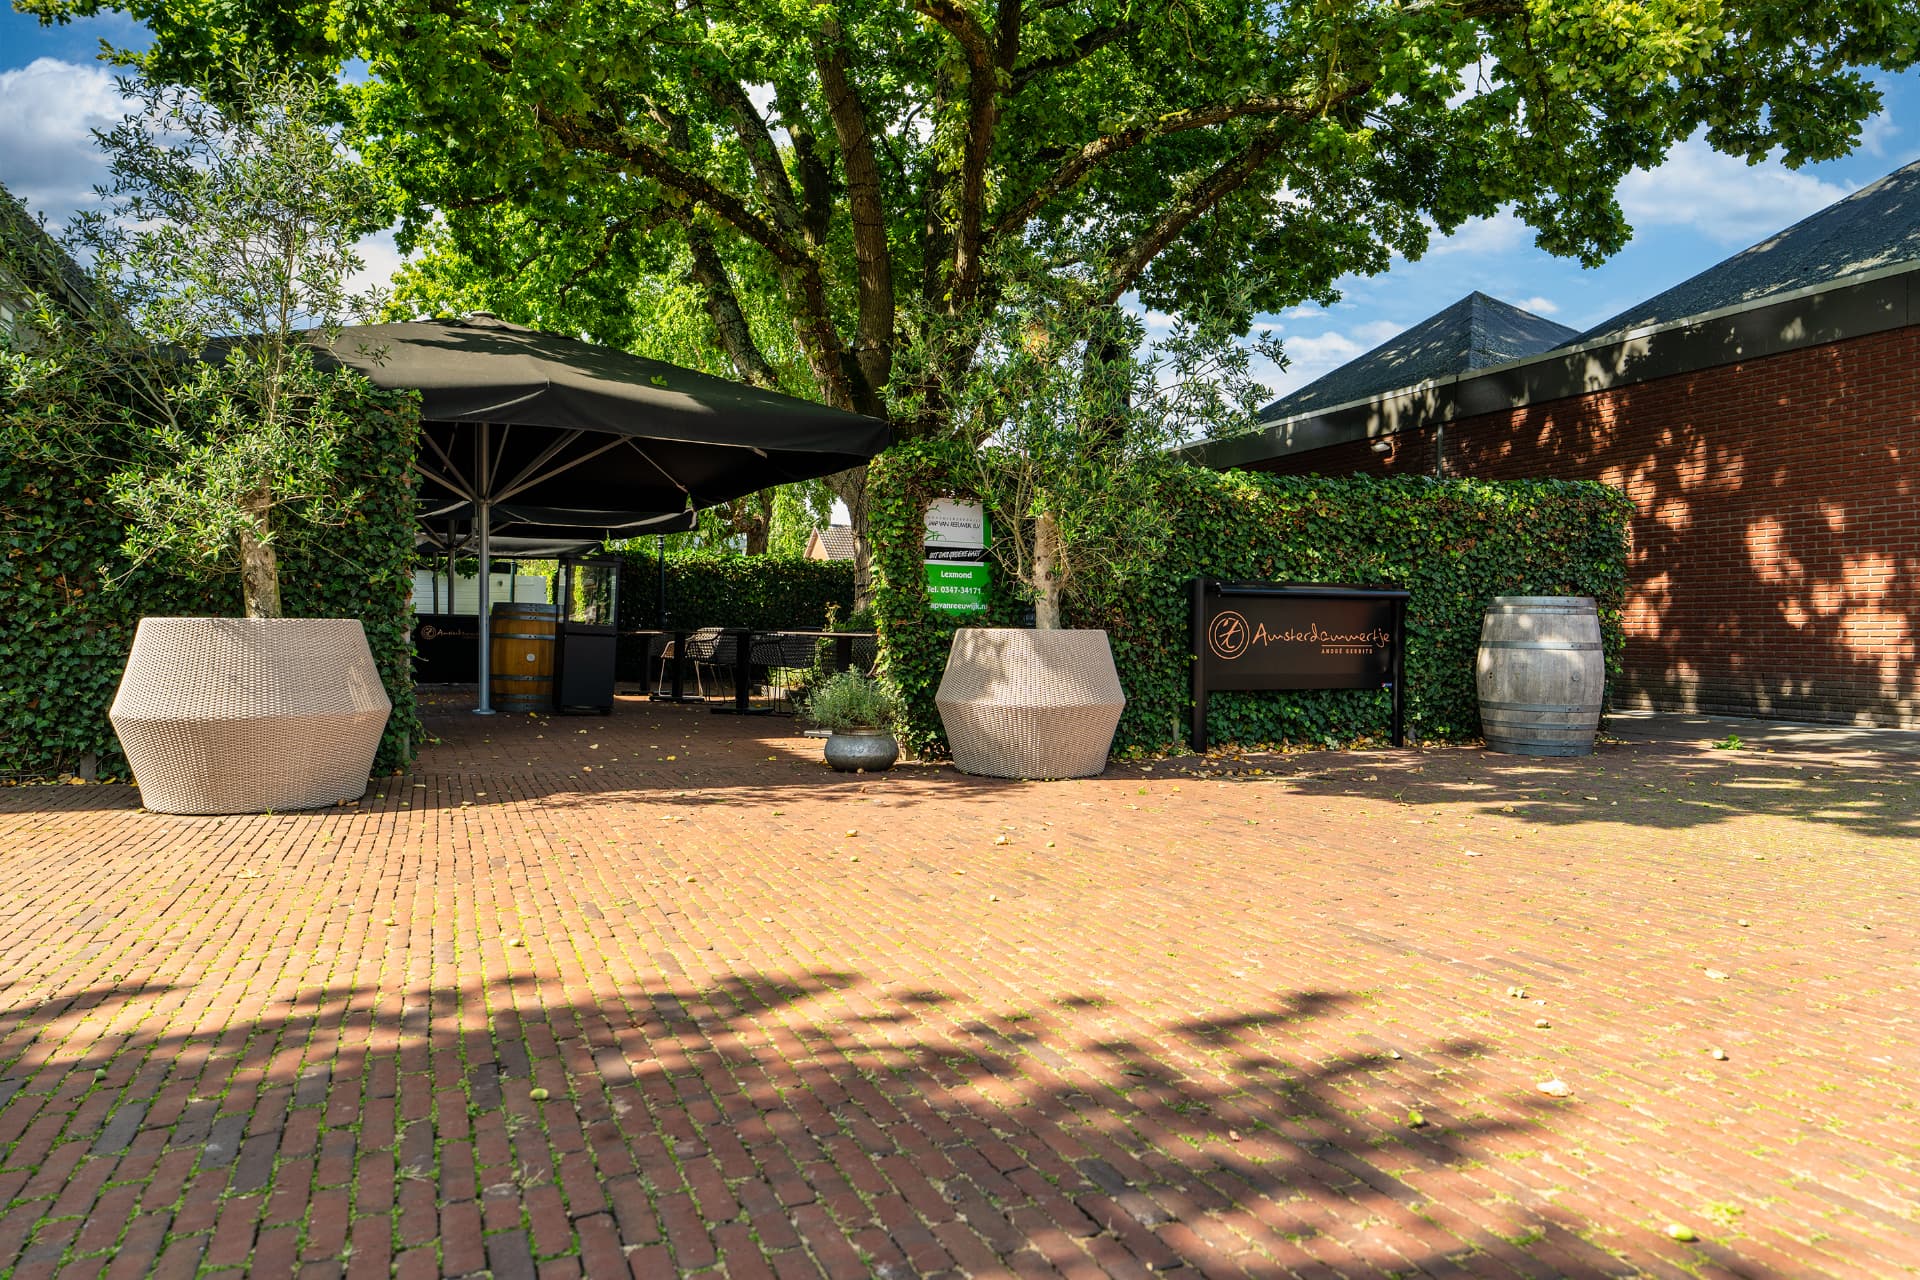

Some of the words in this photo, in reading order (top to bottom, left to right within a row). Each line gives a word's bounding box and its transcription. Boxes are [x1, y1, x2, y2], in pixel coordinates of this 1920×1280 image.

[940, 570, 973, 579] Lexmond
[940, 586, 984, 595] 0347-34171
[1252, 622, 1391, 648] Amsterdammertje
